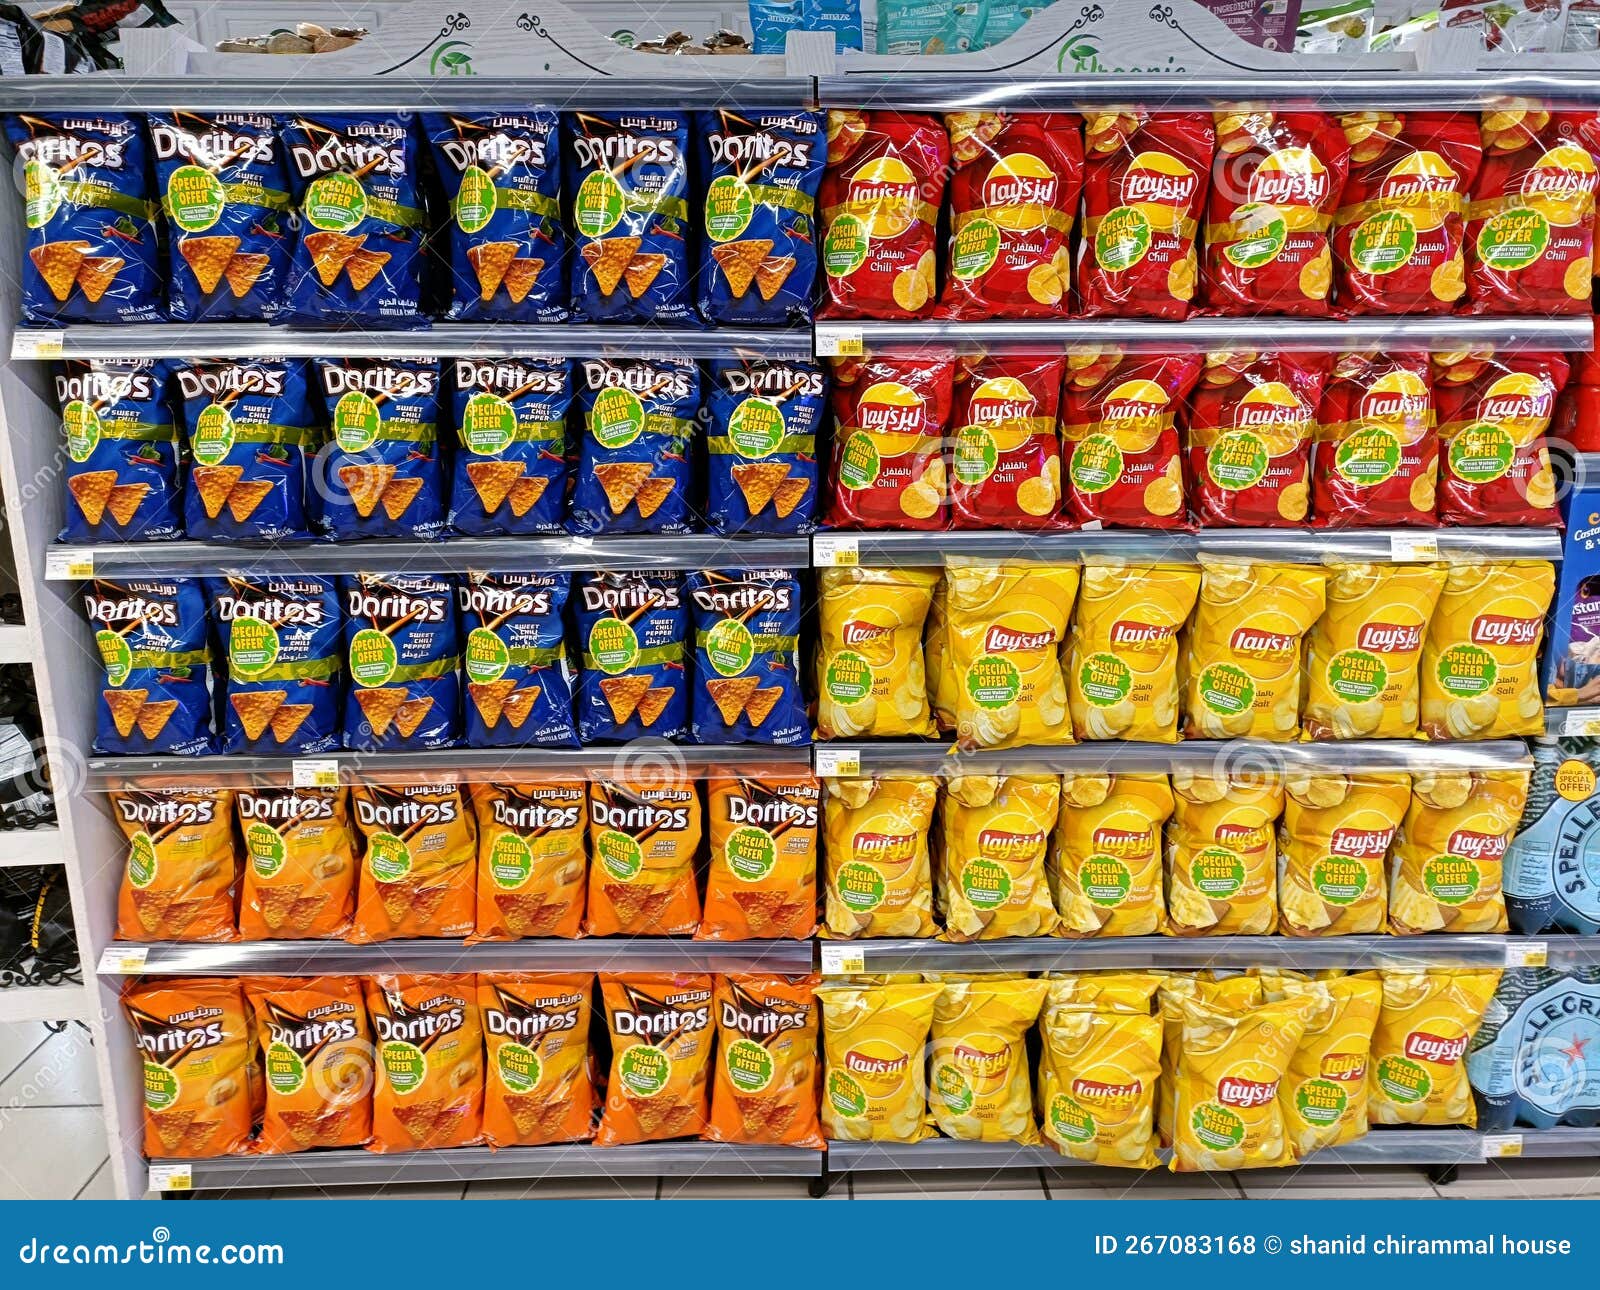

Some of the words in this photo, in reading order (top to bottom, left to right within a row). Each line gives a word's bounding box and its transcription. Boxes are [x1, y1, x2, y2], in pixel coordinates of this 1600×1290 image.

[154, 127, 274, 163] Doritos
[575, 136, 675, 169] Doritos
[710, 134, 809, 165] Doritos
[990, 178, 1031, 205] Lay's
[1127, 175, 1171, 201] Lay's
[179, 368, 285, 399] Doritos
[324, 368, 436, 393] Doritos
[457, 361, 562, 392] Doritos
[586, 363, 688, 393] Doritos
[727, 369, 823, 396] Doritos
[243, 405, 272, 414] SWEET
[525, 402, 551, 410] SWEET
[862, 406, 899, 434] Lay's
[351, 592, 444, 621] Doritos
[459, 587, 548, 614] Doritos
[584, 588, 679, 610] Doritos
[692, 588, 789, 610] Doritos
[219, 597, 322, 622] Doritos
[989, 626, 1028, 651] Lay's
[1361, 626, 1399, 651] Lay's
[1476, 619, 1521, 645] Lay's
[833, 659, 865, 671] SPECIAL
[1089, 660, 1124, 675] SPECIAL
[1339, 656, 1381, 671] SPECIAL
[1447, 651, 1489, 665] SPECIAL
[836, 671, 861, 683] OFFER
[973, 664, 1012, 676] SPECIAL
[1091, 672, 1118, 685] OFFER
[1210, 667, 1250, 686] SPECIAL
[1342, 668, 1373, 683] OFFER
[1451, 664, 1483, 676] OFFER
[979, 675, 1008, 687] OFFER
[1213, 677, 1242, 697] OFFER
[1559, 776, 1591, 784] SPECIAL
[1559, 783, 1591, 792] OFFER
[120, 801, 212, 823] Doritos
[239, 795, 333, 819] Doritos
[358, 801, 456, 825] Doritos
[495, 800, 579, 827] Doritos
[593, 801, 688, 828] Doritos
[730, 798, 817, 825] Doritos
[1335, 832, 1374, 856] Lay's
[1452, 836, 1492, 860] Lay's
[968, 864, 1004, 878] SPECIAL
[1086, 863, 1122, 875] SPECIAL
[1198, 855, 1236, 868] SPECIAL
[1320, 862, 1361, 875] SPECIAL
[1431, 860, 1472, 874] SPECIAL
[843, 867, 878, 883] SPECIAL
[1090, 874, 1119, 886] OFFER
[1203, 867, 1233, 878] OFFER
[1326, 873, 1356, 885] OFFER
[1436, 872, 1468, 884] OFFER
[846, 879, 873, 893] OFFER
[972, 877, 999, 890] OFFER
[376, 1009, 463, 1040] Doritos
[488, 1009, 576, 1036] Doritos
[615, 1008, 707, 1035] Doritos
[723, 1005, 804, 1033] Doritos
[272, 1018, 356, 1050] Doritos
[383, 1049, 416, 1062] SPECIAL
[502, 1051, 533, 1065] SPECIAL
[733, 1047, 766, 1062] SPECIAL
[1409, 1036, 1450, 1061] Lay's
[630, 1051, 662, 1066] SPECIAL
[1386, 1057, 1424, 1080] SPECIAL
[833, 1072, 860, 1095] SPECIAL
[1389, 1070, 1418, 1088] OFFER
[835, 1085, 856, 1103] OFFER
[1222, 1081, 1263, 1105] Lay's
[1304, 1084, 1342, 1098] SPECIAL
[1055, 1099, 1088, 1120] SPECIAL
[1308, 1096, 1337, 1109] OFFER
[1059, 1112, 1084, 1128] OFFER
[1202, 1106, 1239, 1125] SPECIAL
[1203, 1118, 1232, 1136] OFFER
